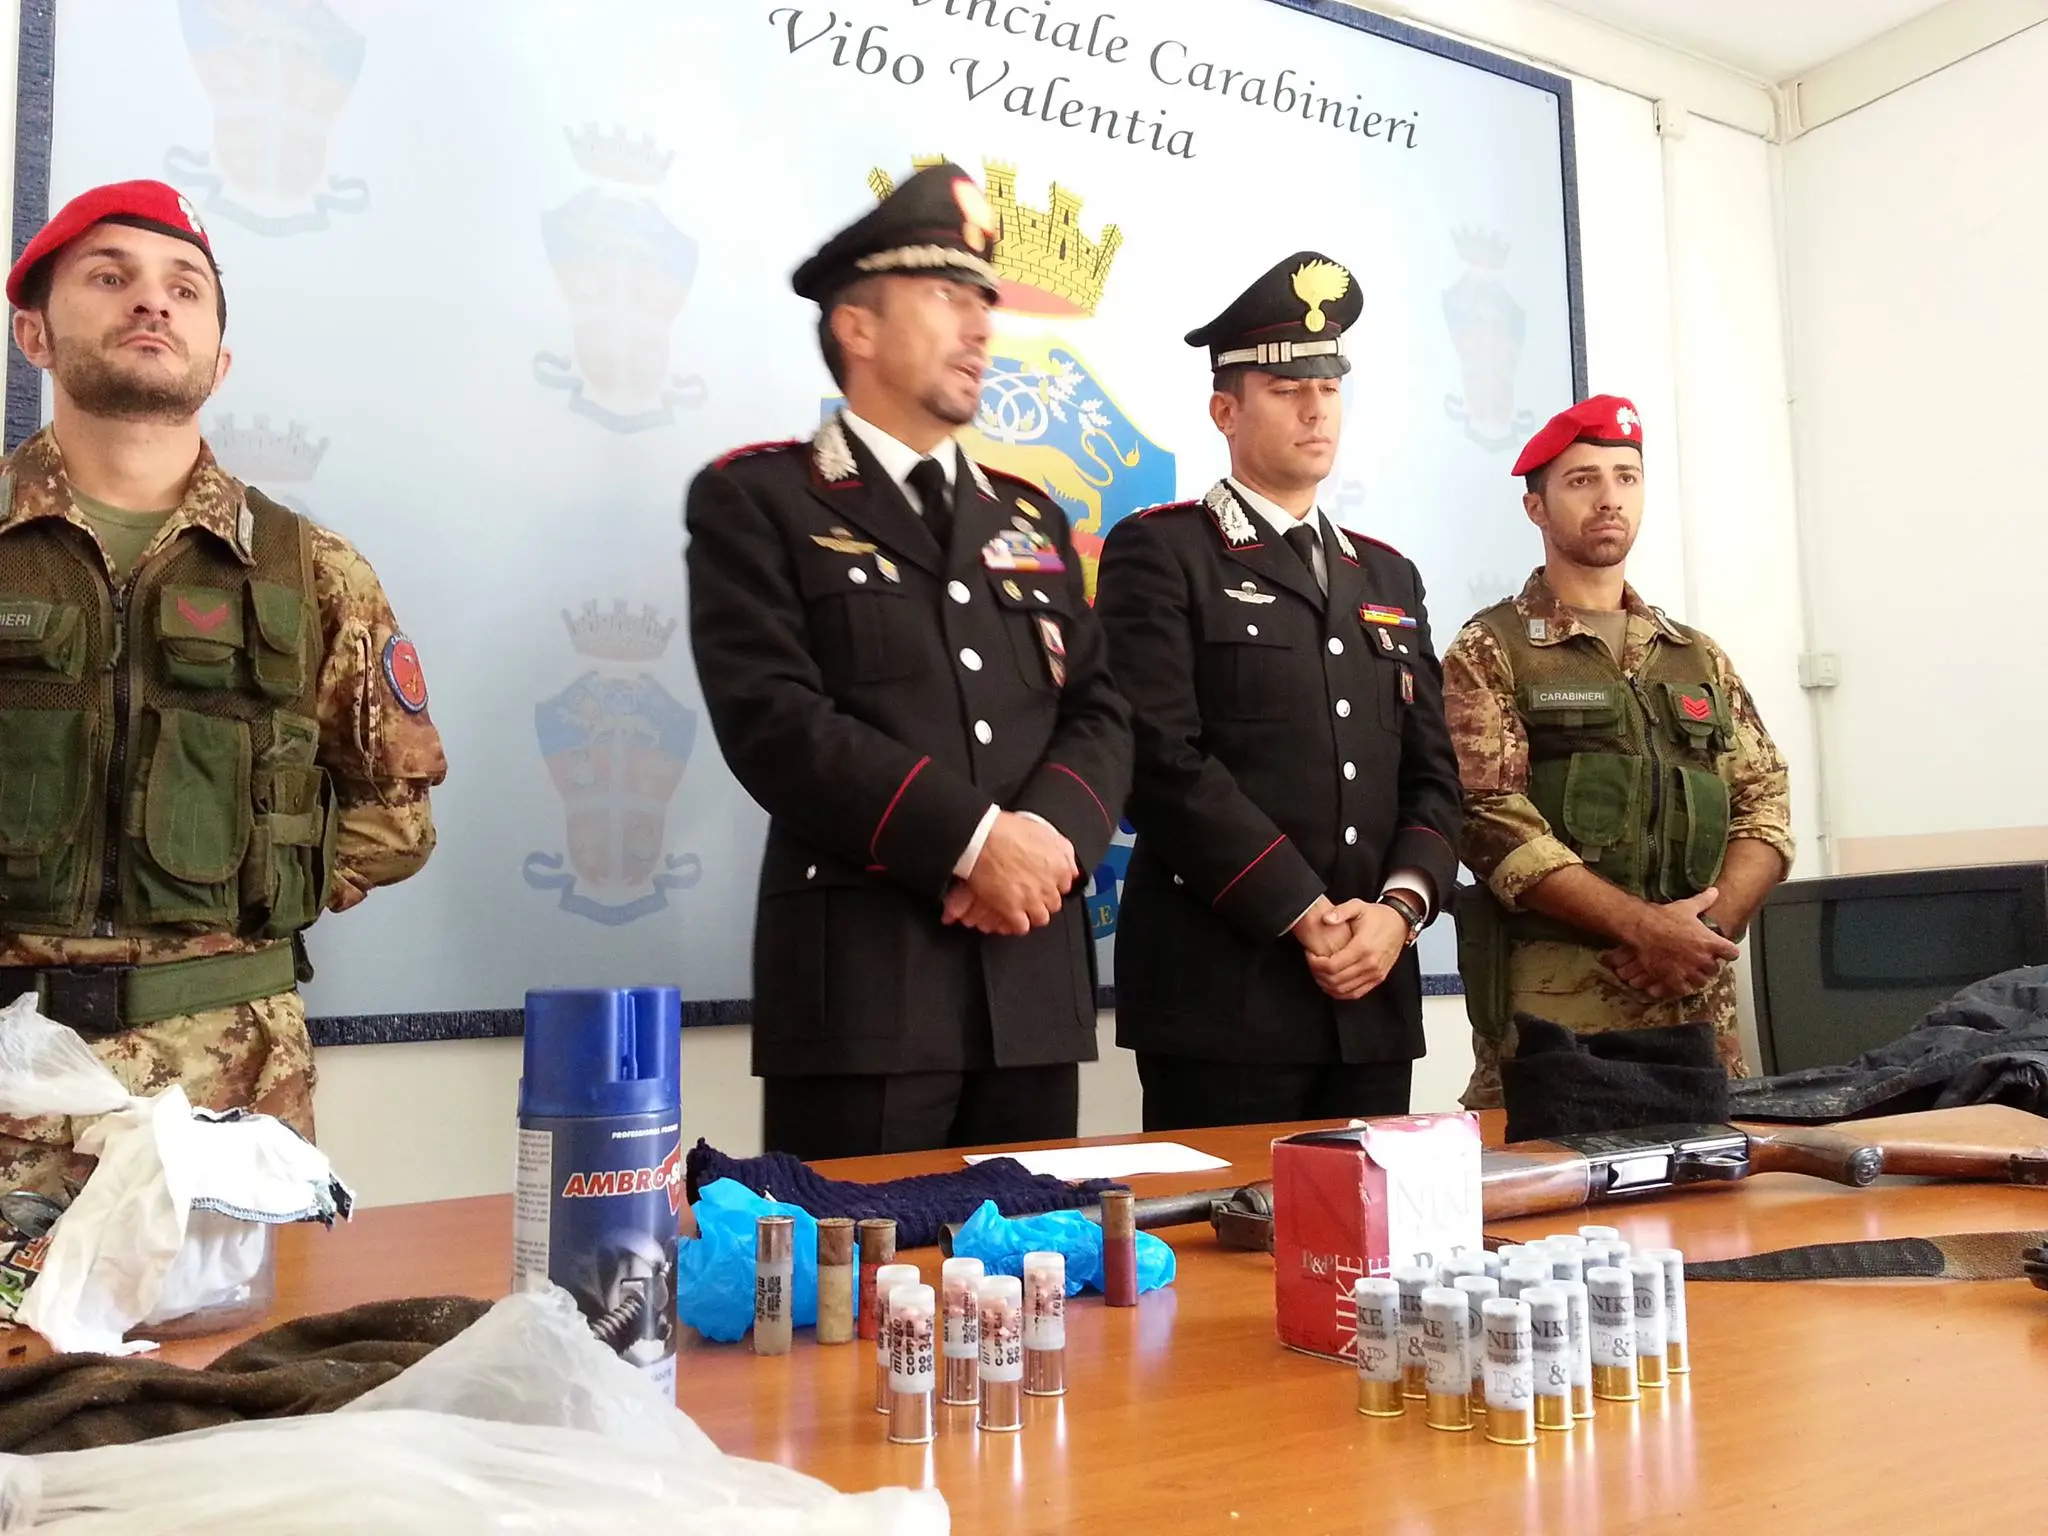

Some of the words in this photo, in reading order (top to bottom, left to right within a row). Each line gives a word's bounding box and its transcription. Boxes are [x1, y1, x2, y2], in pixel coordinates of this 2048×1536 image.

[768, 8, 925, 85] Vibo
[949, 58, 1196, 159] Valentia
[912, 0, 1128, 63] nciale
[1150, 40, 1418, 149] Carabinieri
[0, 613, 32, 627] IERI
[1539, 691, 1605, 702] CARABINIERI
